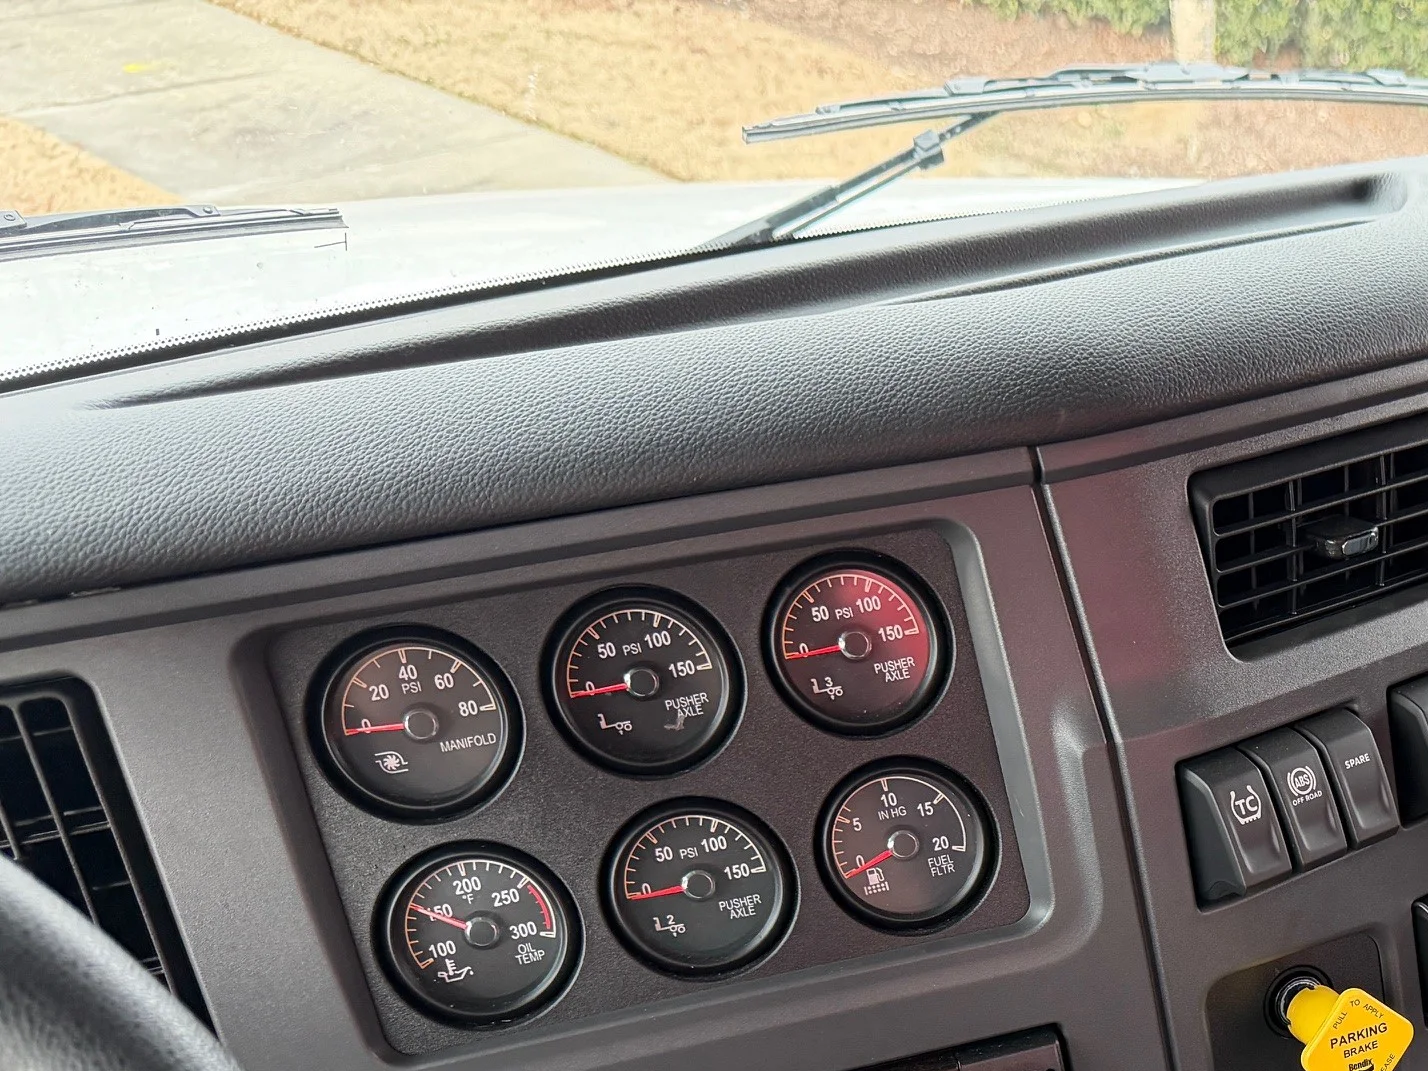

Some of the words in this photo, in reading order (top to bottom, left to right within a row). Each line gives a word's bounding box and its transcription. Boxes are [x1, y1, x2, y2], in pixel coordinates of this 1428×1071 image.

[856, 596, 881, 613] 100
[811, 605, 830, 622] 50
[835, 607, 854, 620] PSI
[645, 631, 671, 649] 100
[879, 625, 903, 642] 150
[597, 642, 616, 659] 50
[622, 643, 642, 656] PSI
[398, 664, 418, 681] 40
[669, 660, 695, 678] 150
[874, 657, 915, 674] PUSHER
[434, 673, 454, 690] 60
[885, 669, 910, 682] AXLE
[369, 684, 390, 701] 20
[401, 682, 422, 695] PSI
[458, 700, 478, 717] 80
[665, 692, 709, 710] PUSHER
[677, 705, 704, 718] AXLE
[440, 732, 497, 753] MANIFOLD
[1344, 752, 1370, 769] SPARE
[1294, 774, 1310, 788] ABS
[880, 793, 897, 808] 10
[1234, 796, 1258, 815] TC
[1292, 796, 1305, 806] OFF
[1305, 790, 1323, 802] ROAD
[878, 811, 889, 821] IN
[891, 806, 907, 818] HG
[917, 802, 934, 817] 15
[853, 818, 862, 831] 5
[701, 835, 727, 853] 100
[932, 836, 949, 851] 20
[655, 846, 673, 862] 50
[680, 847, 699, 860] PSI
[928, 854, 954, 868] FUEL
[724, 863, 750, 881] 150
[931, 865, 955, 877] FLTR
[453, 876, 482, 895] 200
[491, 888, 520, 907] 250
[719, 894, 762, 911] PUSHER
[730, 905, 756, 919] AXLE
[509, 921, 537, 940] 300
[428, 940, 456, 959] 100
[518, 942, 536, 954] OIL
[515, 950, 546, 965] TEMP
[1332, 1011, 1348, 1029] PULL
[1350, 999, 1361, 1007] TO
[1363, 1003, 1384, 1019] APPLY
[1330, 1022, 1388, 1049] PARKING
[1343, 1040, 1379, 1058] BRAKE
